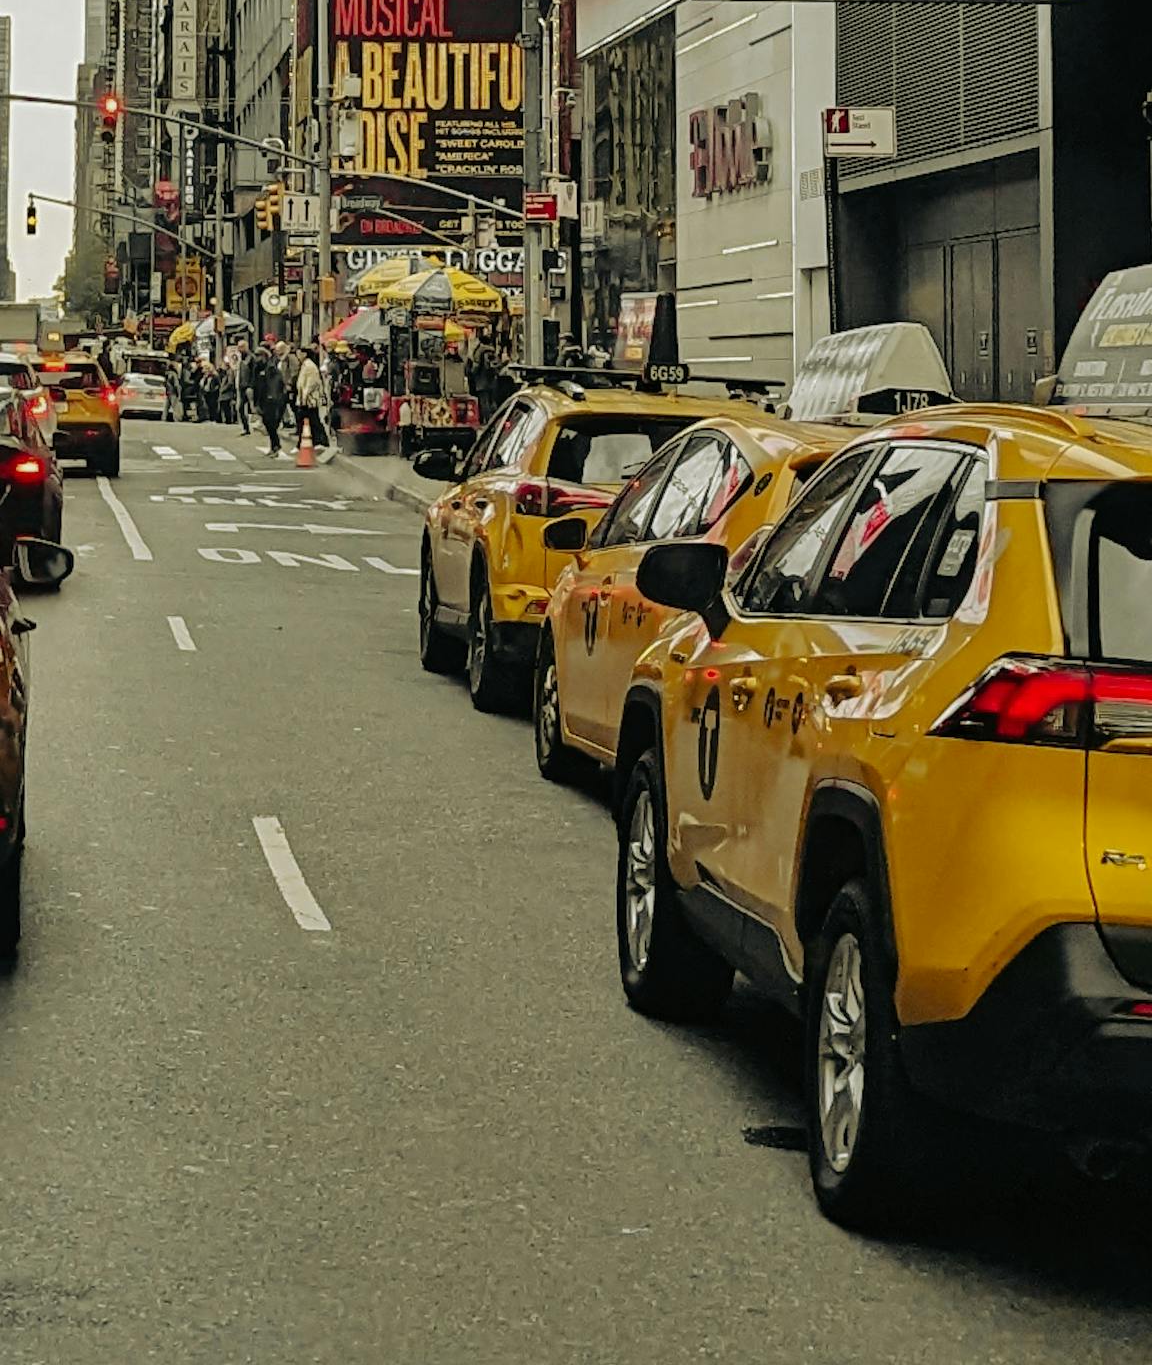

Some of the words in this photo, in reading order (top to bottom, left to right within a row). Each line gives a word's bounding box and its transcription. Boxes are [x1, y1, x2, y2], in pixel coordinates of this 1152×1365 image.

[361, 41, 524, 111] BEAUTIFU
[650, 365, 684, 382] 6G59
[894, 391, 929, 414] 1J78
